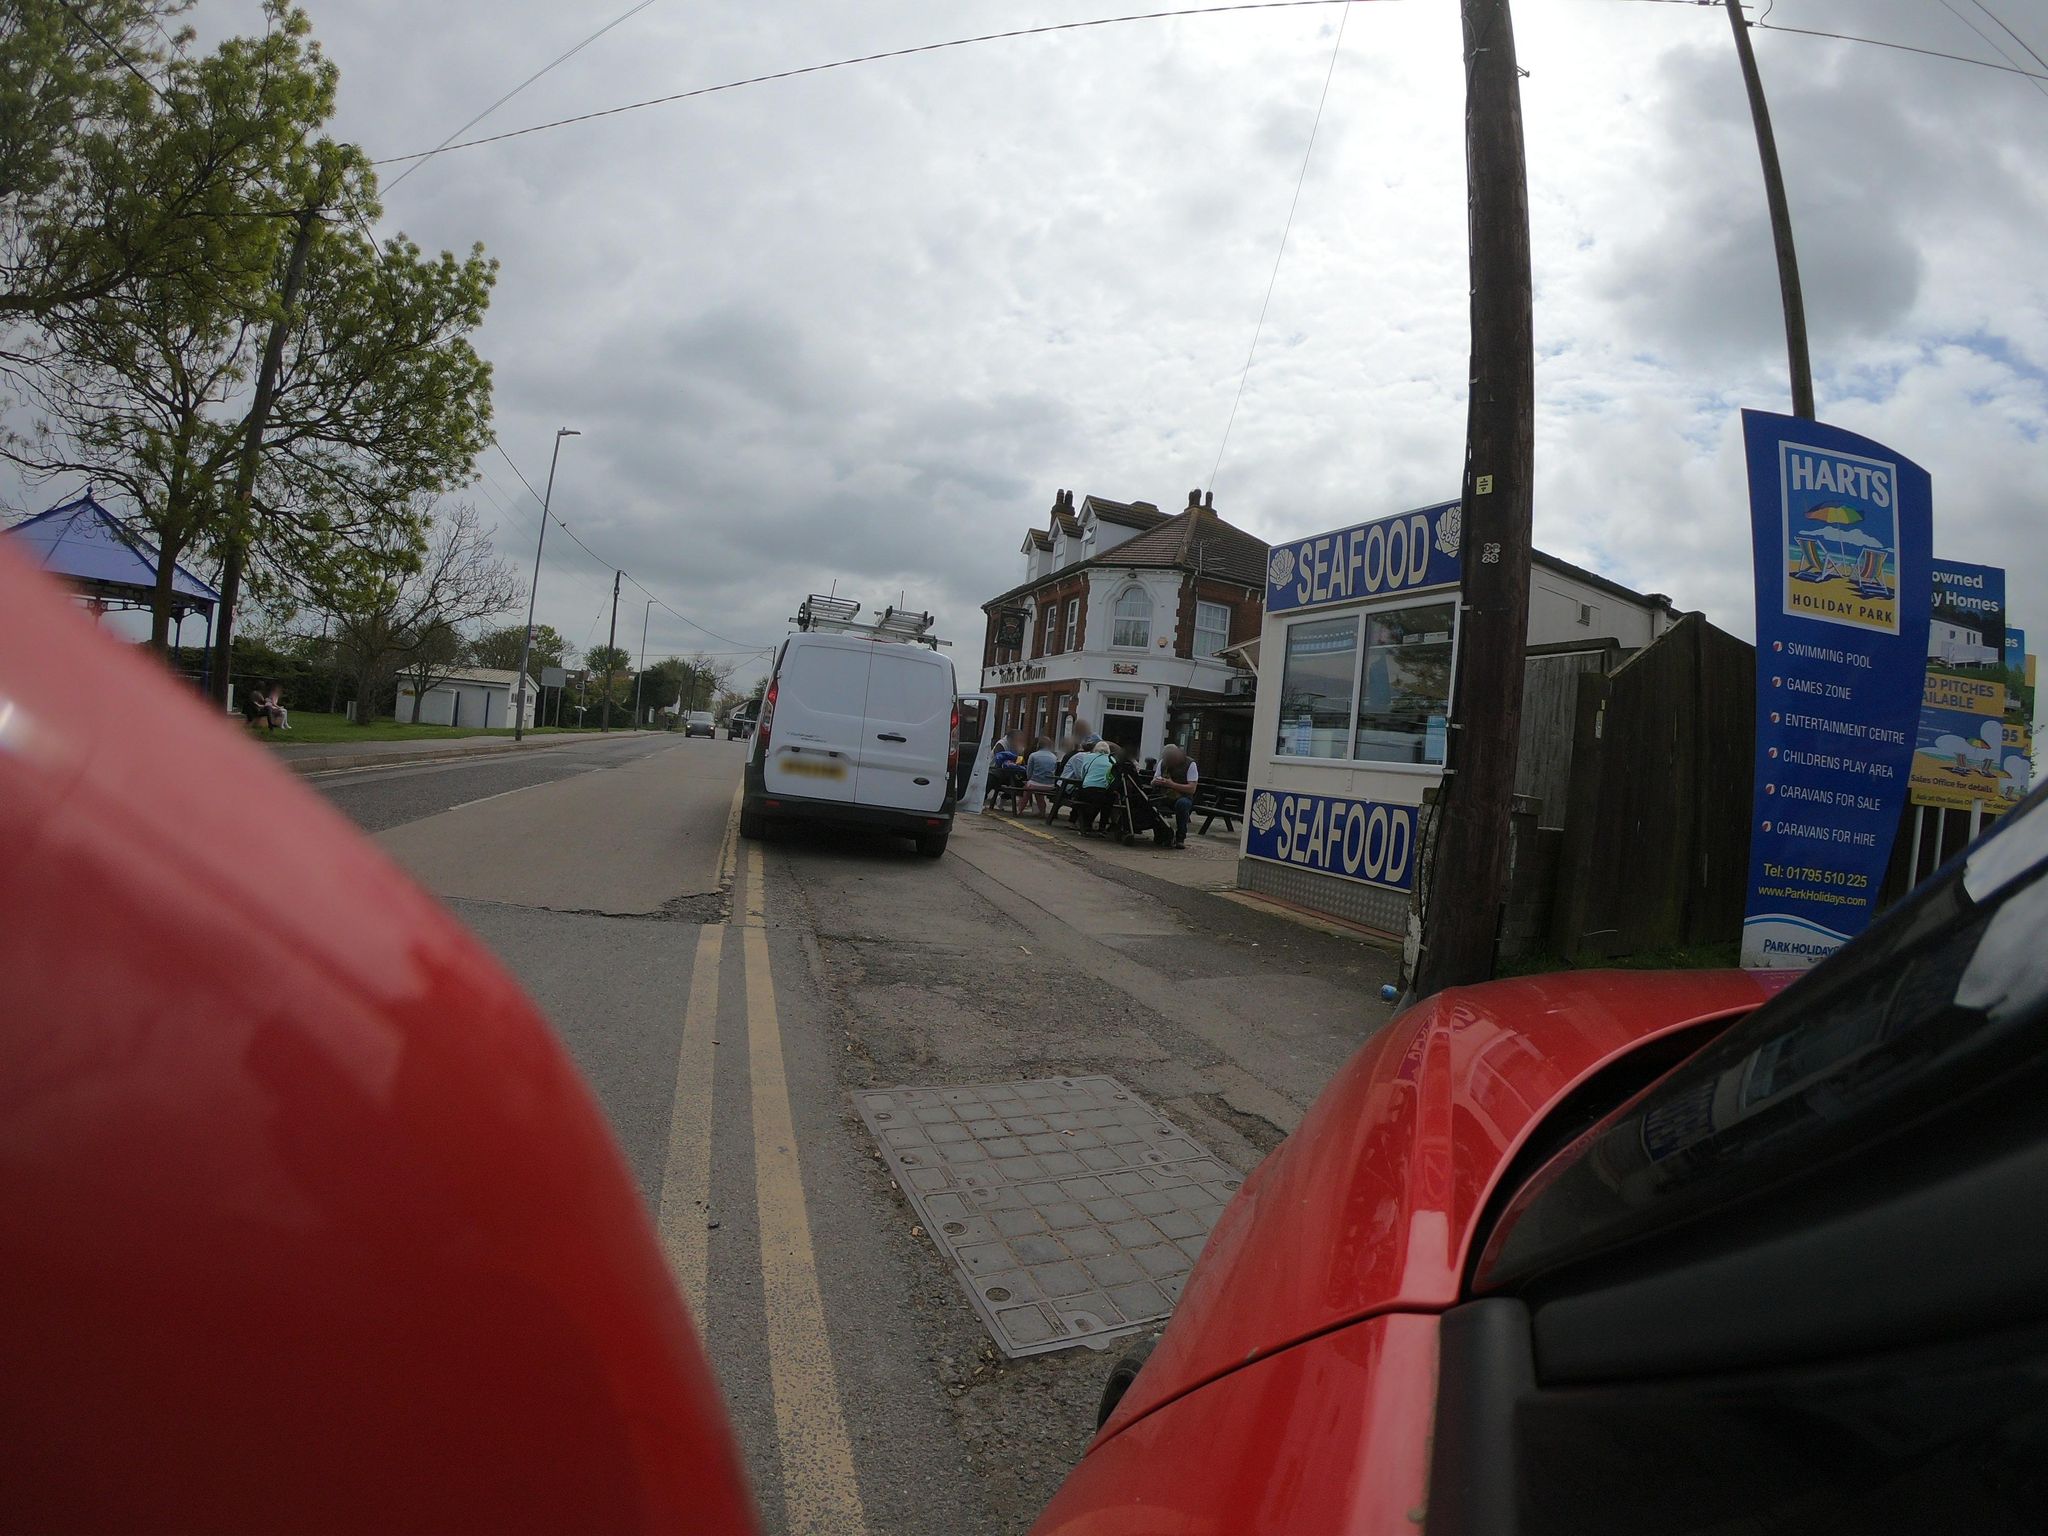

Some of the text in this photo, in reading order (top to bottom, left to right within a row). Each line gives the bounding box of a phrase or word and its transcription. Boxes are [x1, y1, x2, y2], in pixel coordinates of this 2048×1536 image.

[1791, 454, 1890, 508] HARTS
[1298, 514, 1430, 605] SEAFOOD
[1482, 553, 1499, 563] 23
[1793, 594, 1893, 623] HOLIDAY PARK
[1945, 591, 1999, 612] Homes
[1787, 642, 1872, 669] SWIMMING POOL
[1787, 677, 1852, 700] GAMES ZONE
[1940, 679, 1994, 698] PITCHES
[1785, 713, 1905, 745] ENTERTAINMENT CENTRE
[1783, 749, 1894, 778] CHILDRENS PLAY AREA
[1780, 784, 1881, 811] CARAVANS FOR SALE
[1933, 778, 1955, 787] Office
[1957, 781, 1967, 789] for
[1968, 783, 1993, 793] details
[1277, 795, 1410, 883] SEAFOOD
[1777, 821, 1876, 847] CARAVANS FOR HIRE
[1764, 863, 1868, 888] Tel: 01795 510 225
[1758, 886, 1867, 906] www.ParkHolidays.com
